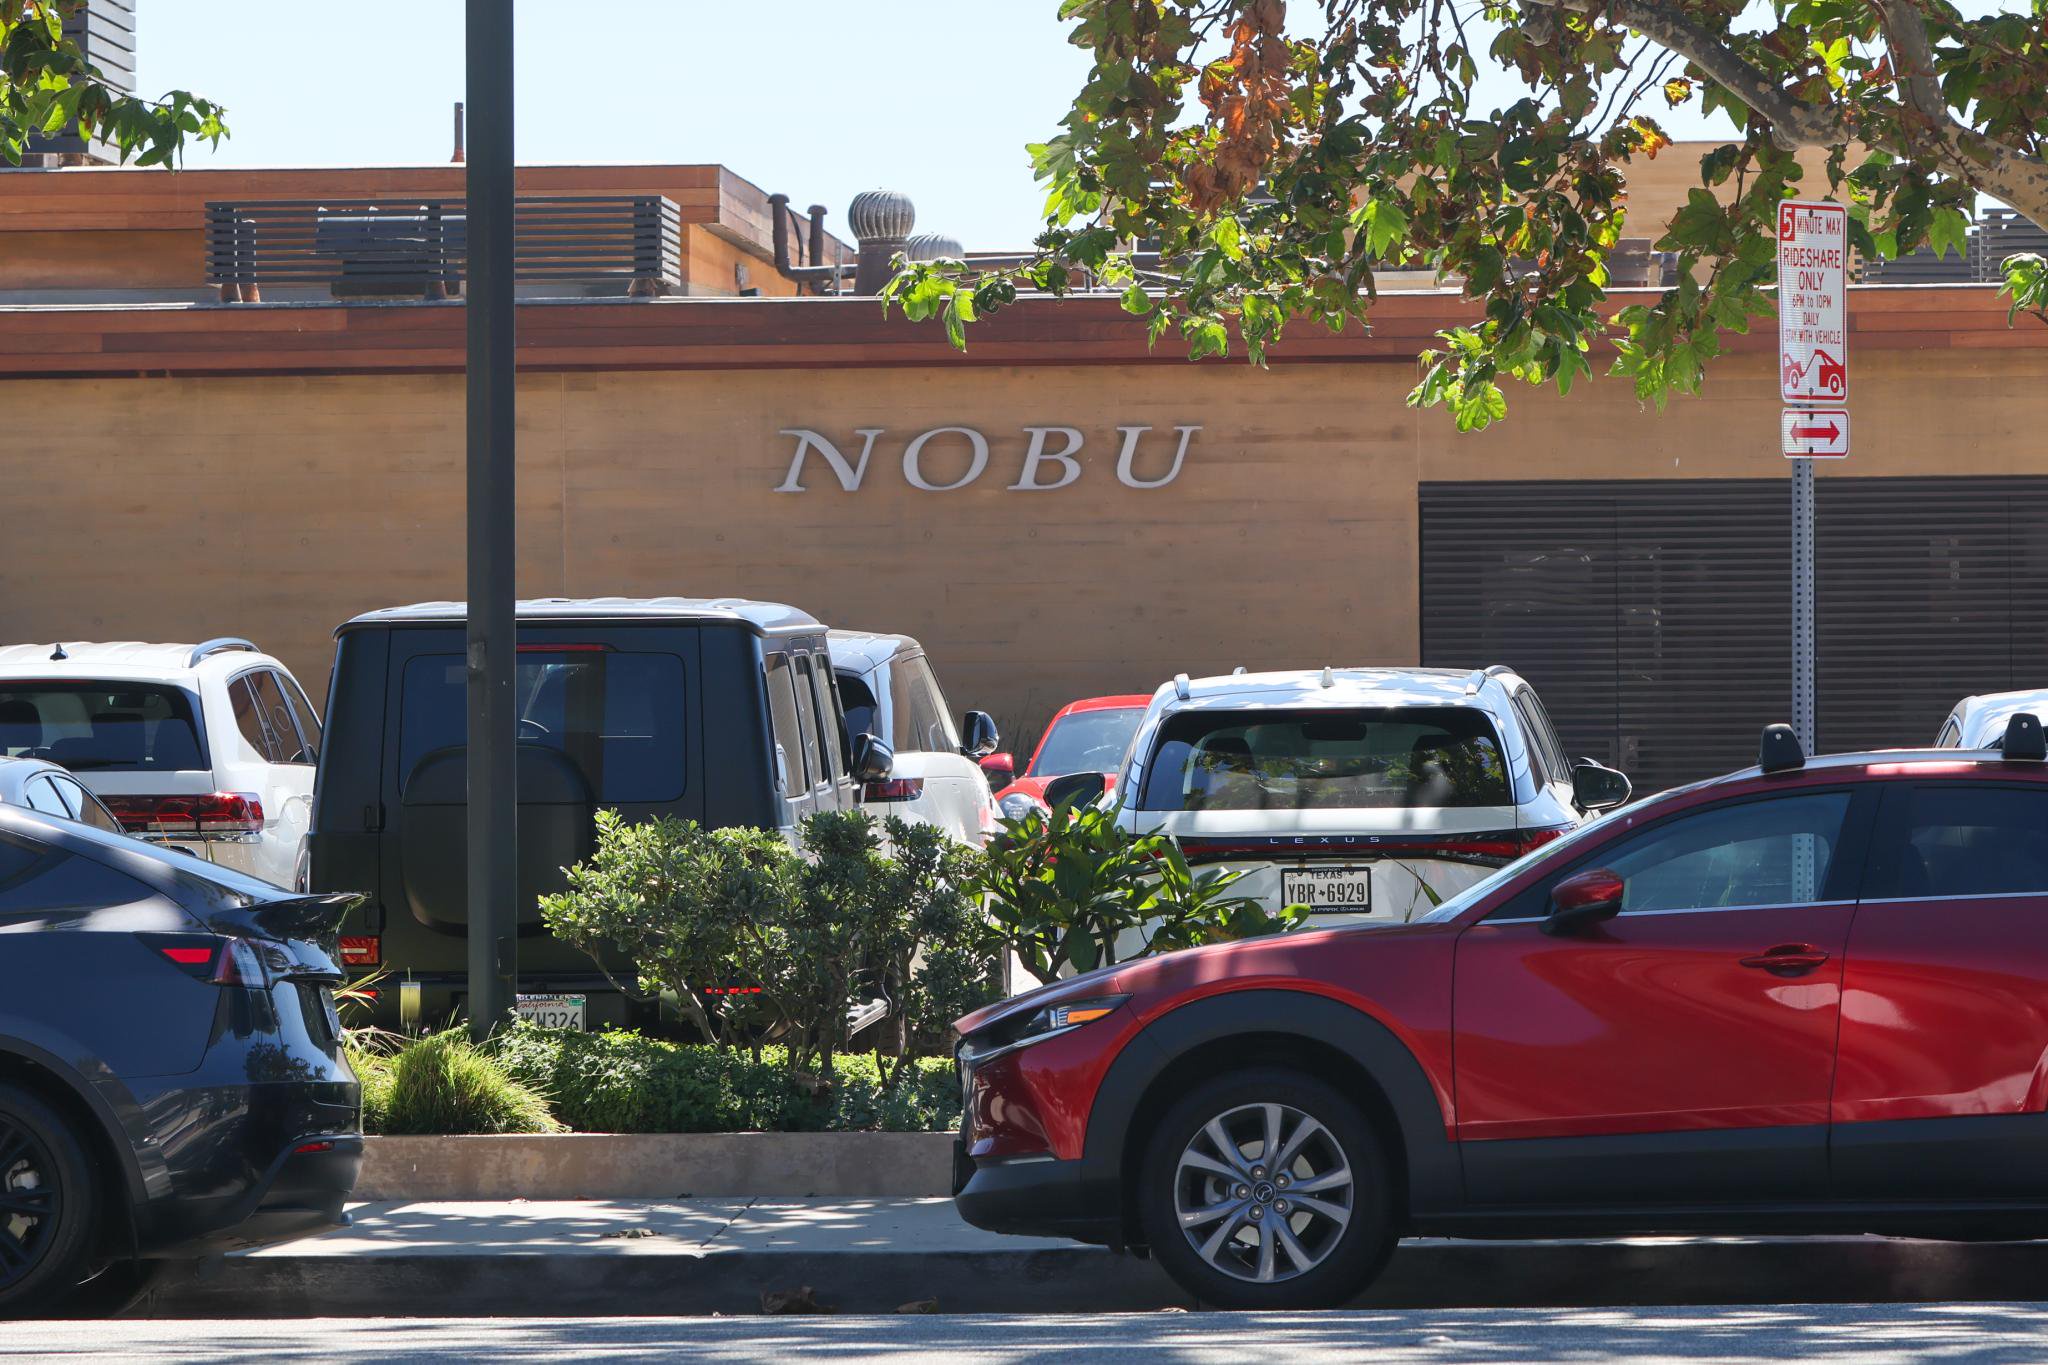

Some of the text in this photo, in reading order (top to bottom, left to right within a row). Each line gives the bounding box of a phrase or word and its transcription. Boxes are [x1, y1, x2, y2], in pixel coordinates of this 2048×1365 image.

[1783, 208, 1841, 238] 5 MINUTE MAX
[1783, 247, 1841, 269] RIDESHARE
[1798, 271, 1824, 291] ONLY
[1792, 293, 1832, 309] 6PM to 10PM
[1803, 311, 1820, 326] DAILY
[1799, 329, 1813, 343] WITH
[1815, 329, 1841, 345] VEHICLE
[773, 425, 1204, 493] NOBU
[1270, 836, 1380, 845] LEXUS
[1311, 871, 1343, 880] TEXAS
